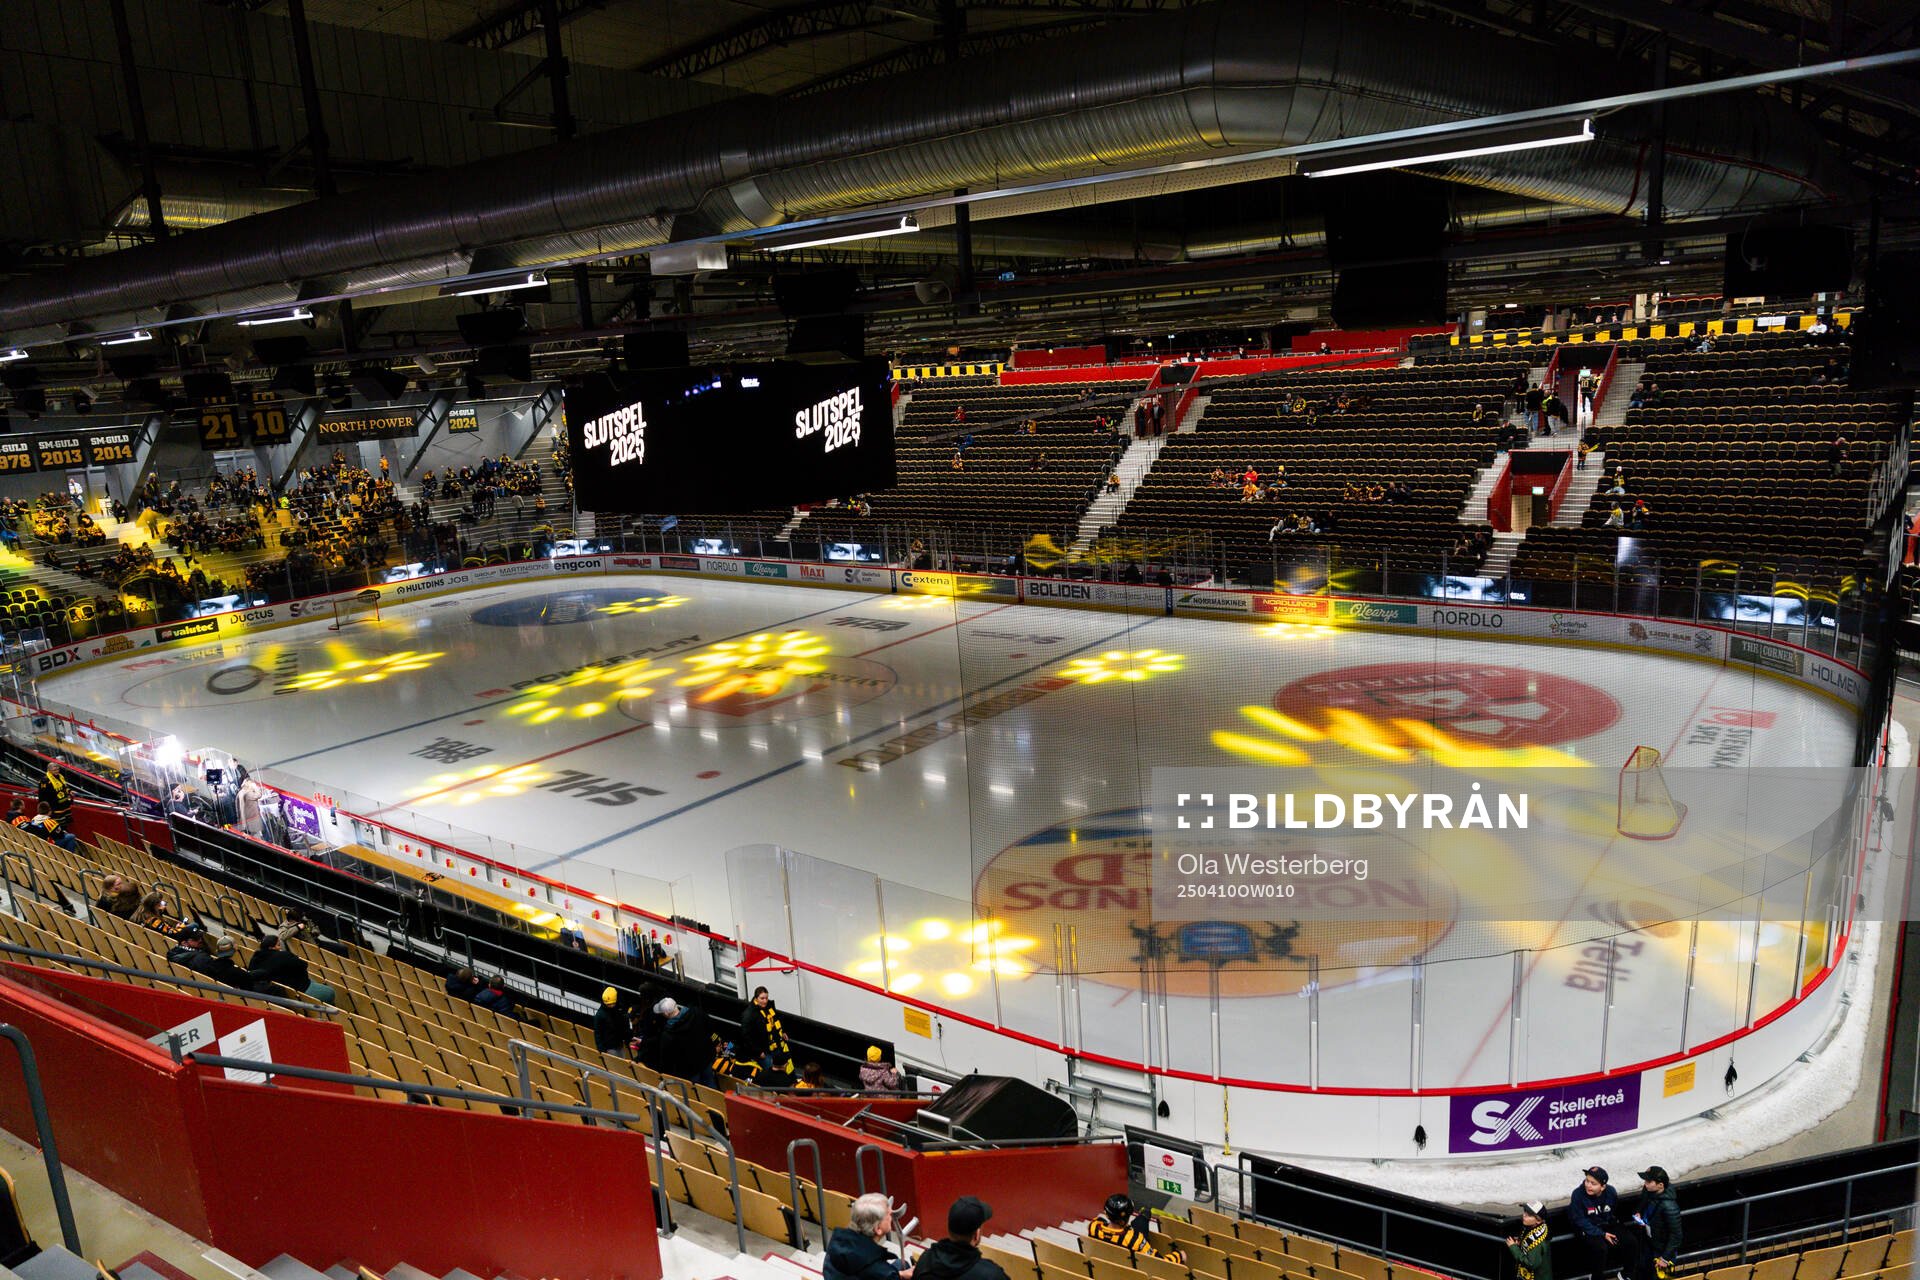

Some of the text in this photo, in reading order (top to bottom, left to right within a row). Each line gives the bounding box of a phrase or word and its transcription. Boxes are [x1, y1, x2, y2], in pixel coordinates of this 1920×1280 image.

[795, 386, 864, 439] SLUTSPEL
[202, 414, 238, 440] 21
[252, 411, 285, 436] 10
[319, 416, 415, 433] NORTH POWER
[449, 417, 477, 430] 2024
[583, 401, 647, 449] SLUTSPEL
[90, 434, 130, 446] SM-GULD
[824, 412, 862, 453] 2025
[38, 438, 80, 450] SM-GULD
[609, 428, 646, 467] 2025
[41, 449, 83, 466] 2013
[93, 445, 133, 461] 2014
[499, 564, 549, 574] MARTINSONS
[554, 559, 601, 571] engcon
[706, 561, 738, 573] NORDLO
[800, 566, 825, 578] MAXI
[406, 579, 445, 593] HULTDINS
[447, 575, 469, 585] JOB
[913, 576, 950, 585] extena
[1029, 582, 1091, 599] BOLIDEN
[230, 609, 274, 625] Ductus
[1350, 602, 1399, 619] O'Learys
[1433, 609, 1503, 628] NORDLO
[173, 622, 214, 637] valutec
[38, 647, 82, 671] BDX
[1763, 645, 1794, 661] CORNER
[1810, 663, 1861, 697] HOLMEN
[534, 770, 668, 806] SHL
[1564, 940, 1645, 994] Telia
[1549, 1089, 1625, 1116] Skellefteå
[1468, 1095, 1546, 1146] SK
[1548, 1113, 1588, 1132] Kraft
